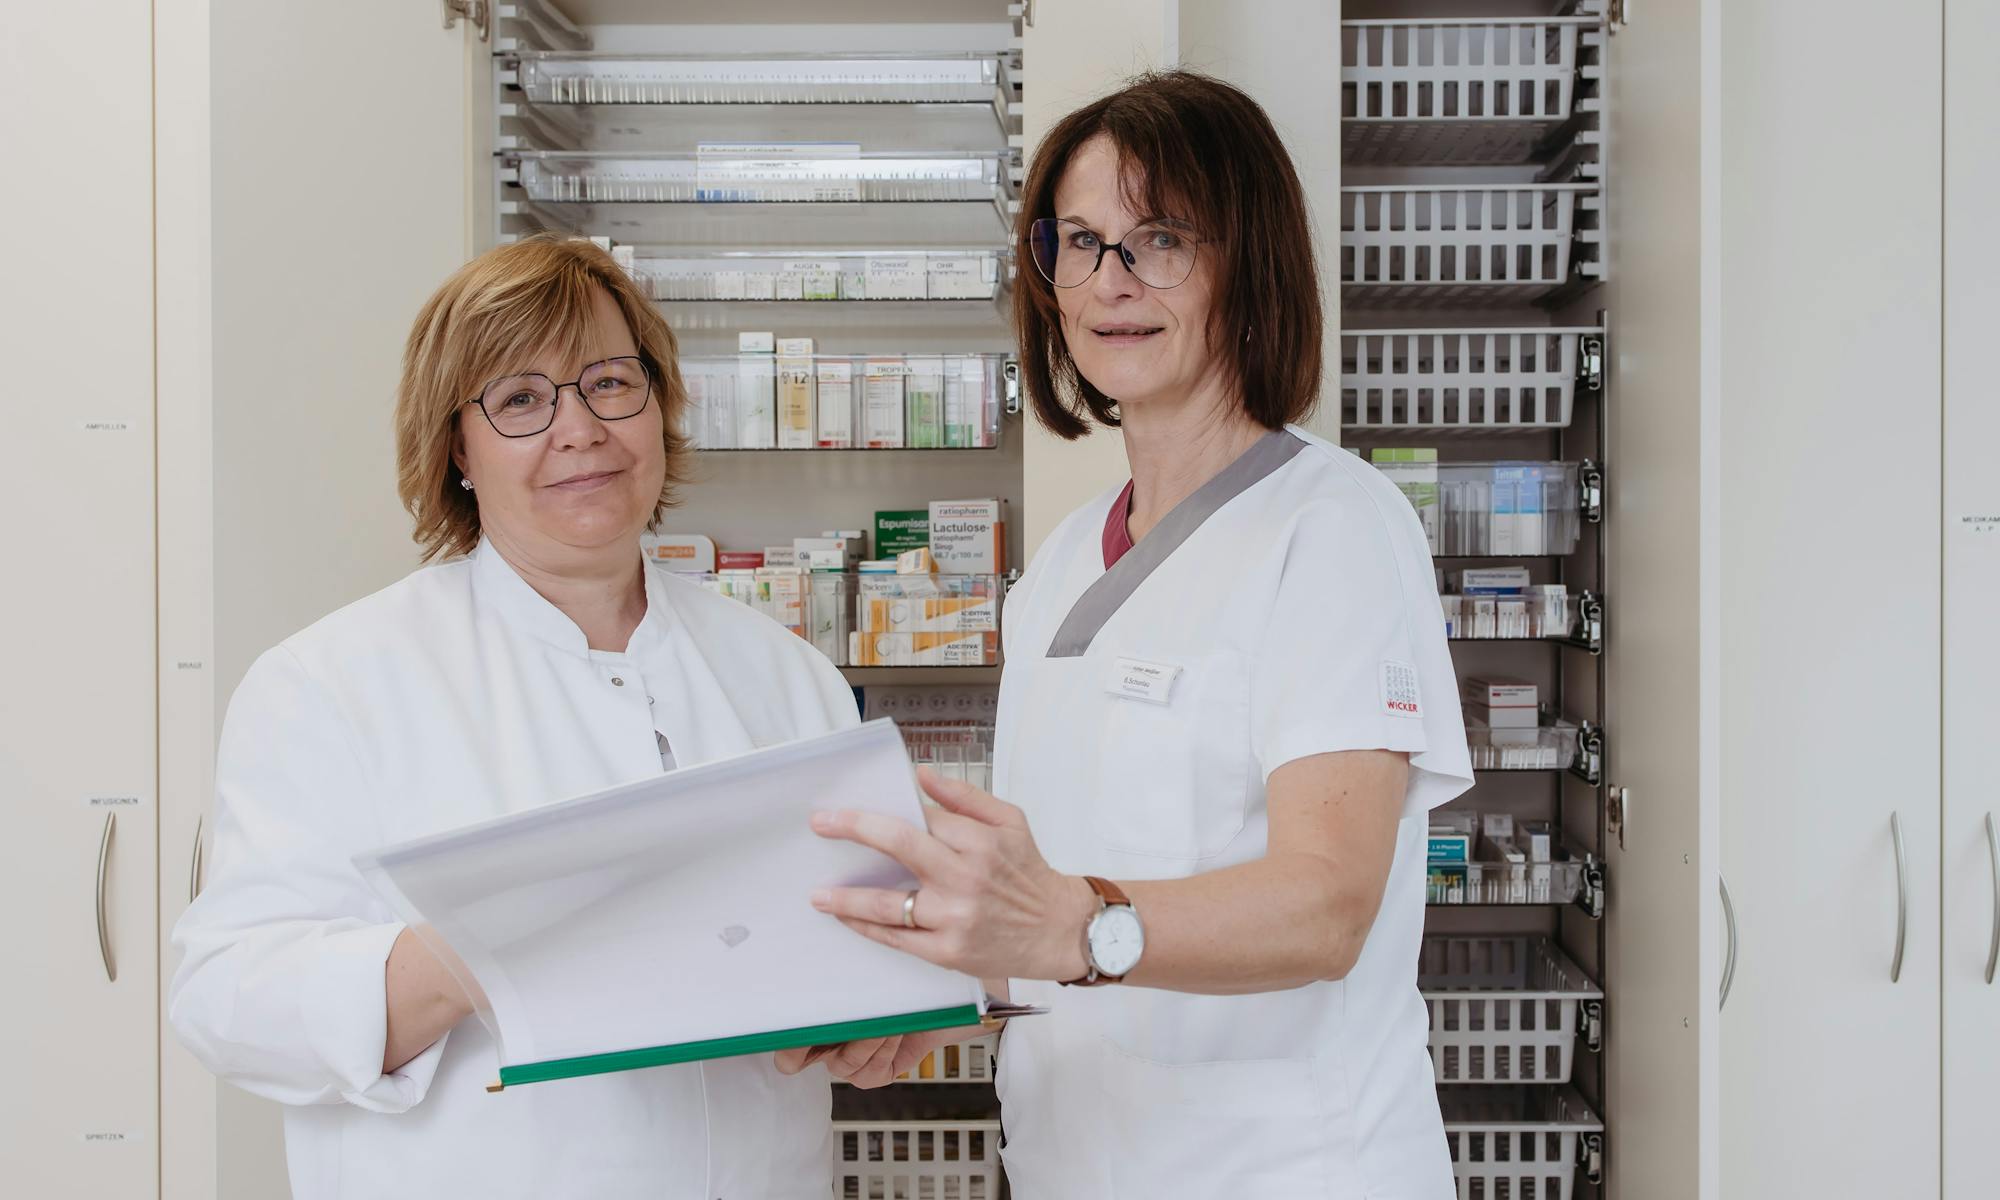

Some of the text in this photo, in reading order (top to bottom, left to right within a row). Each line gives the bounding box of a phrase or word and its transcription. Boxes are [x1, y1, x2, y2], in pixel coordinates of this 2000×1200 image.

[939, 507, 988, 516] ratiopharm
[933, 522, 990, 533] Lactulose-
[934, 543, 954, 551] Sirup
[1386, 700, 1418, 712] WICKER
